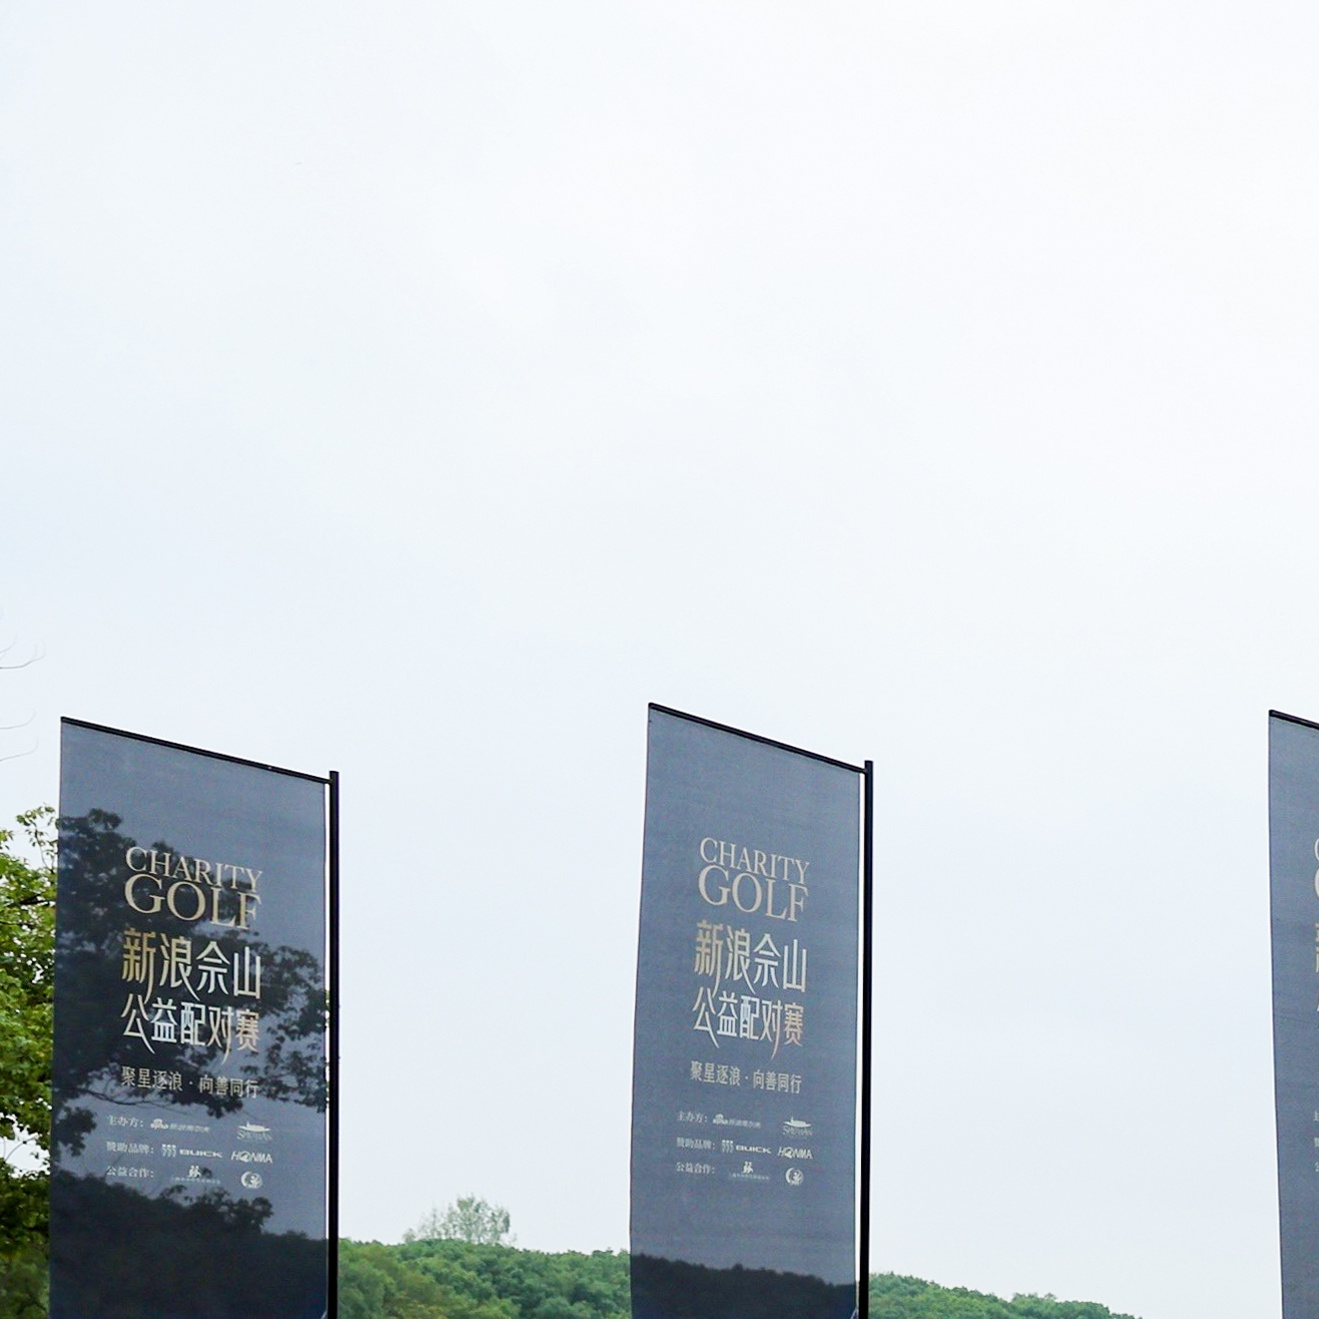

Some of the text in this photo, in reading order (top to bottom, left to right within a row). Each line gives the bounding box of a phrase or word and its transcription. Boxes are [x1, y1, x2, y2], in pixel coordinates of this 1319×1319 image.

[126, 846, 263, 893] CHARITY
[700, 837, 810, 886] CHARITY
[124, 873, 262, 930] GOLF
[698, 865, 808, 922] GOLF
[121, 927, 261, 1004] 新浪佘山
[694, 920, 807, 997] 新浪佘山
[121, 993, 259, 1065] 公益配对赛
[692, 986, 803, 1059] 公益配对赛
[179, 1148, 223, 1159] BUICK
[735, 1144, 771, 1154] BUICK
